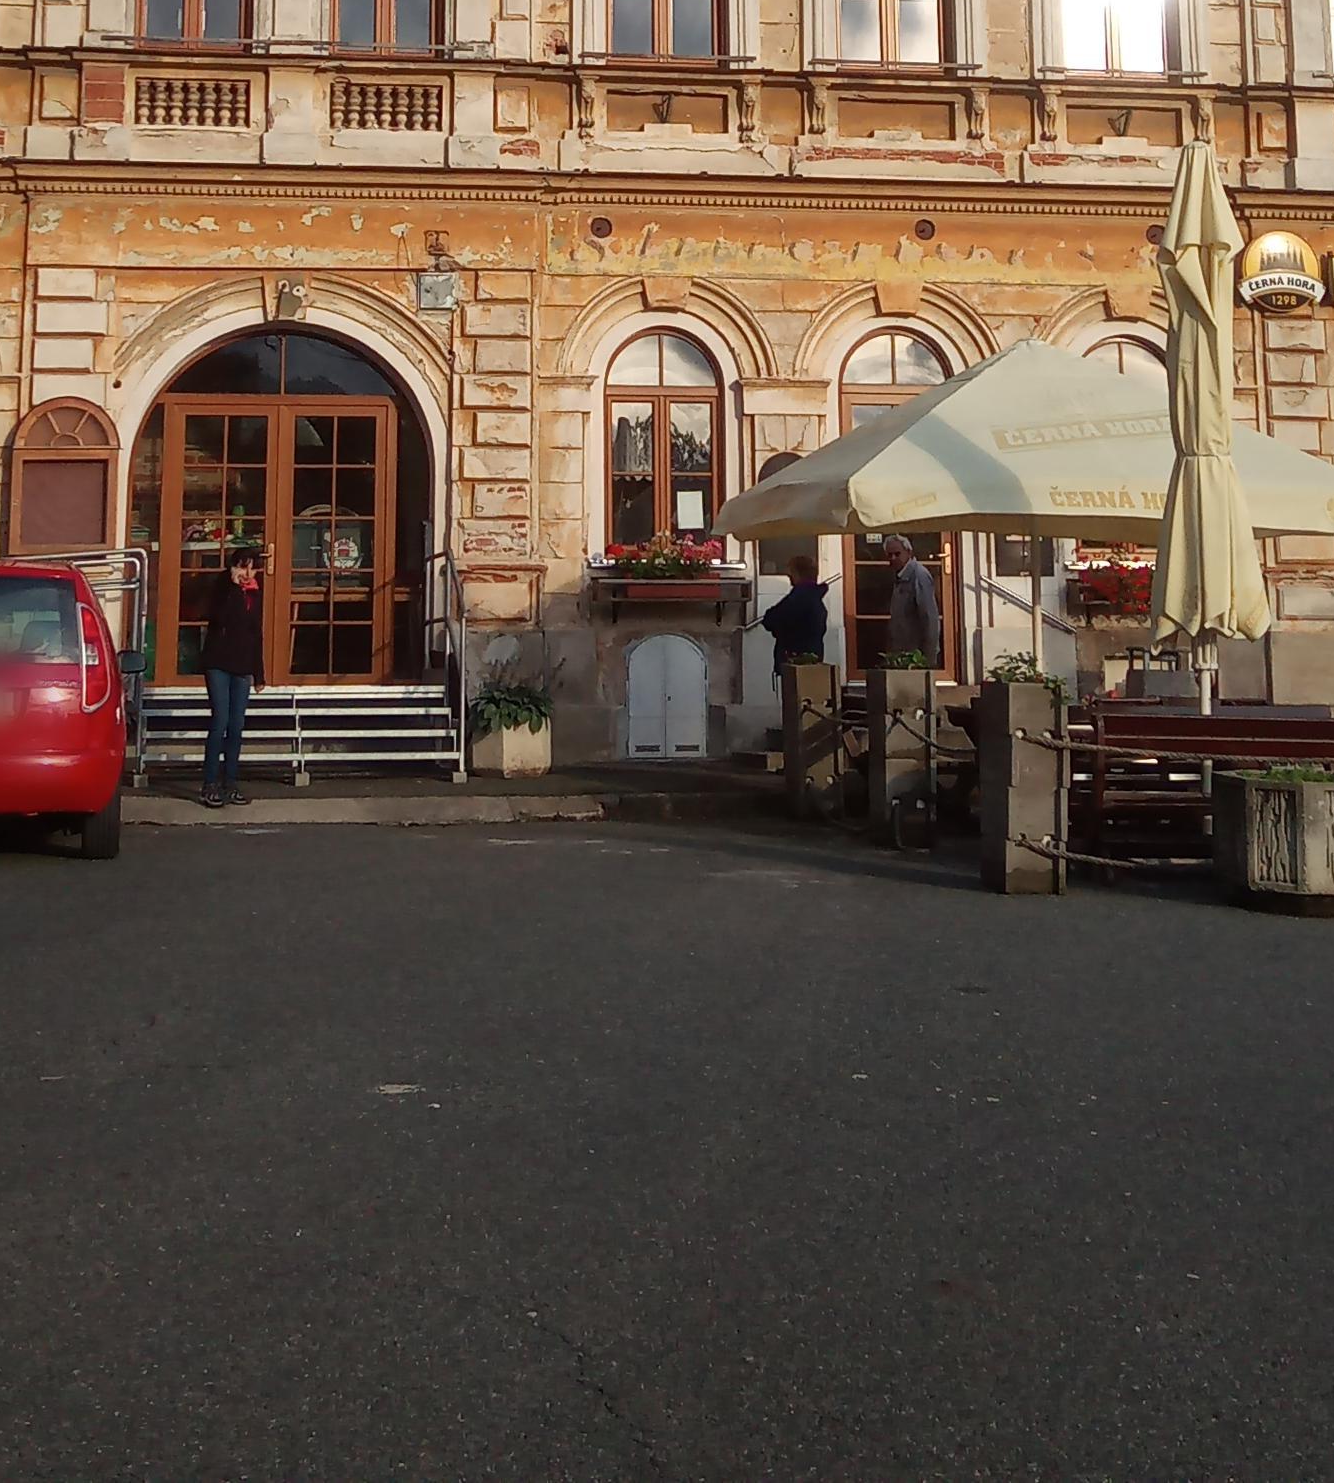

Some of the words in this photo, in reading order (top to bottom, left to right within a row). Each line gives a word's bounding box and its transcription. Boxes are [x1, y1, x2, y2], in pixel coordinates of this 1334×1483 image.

[1248, 276, 1285, 291] ČERNÁ
[1287, 277, 1316, 292] HORA
[1271, 295, 1297, 305] 1298
[1049, 485, 1135, 509] ČERNÁ
